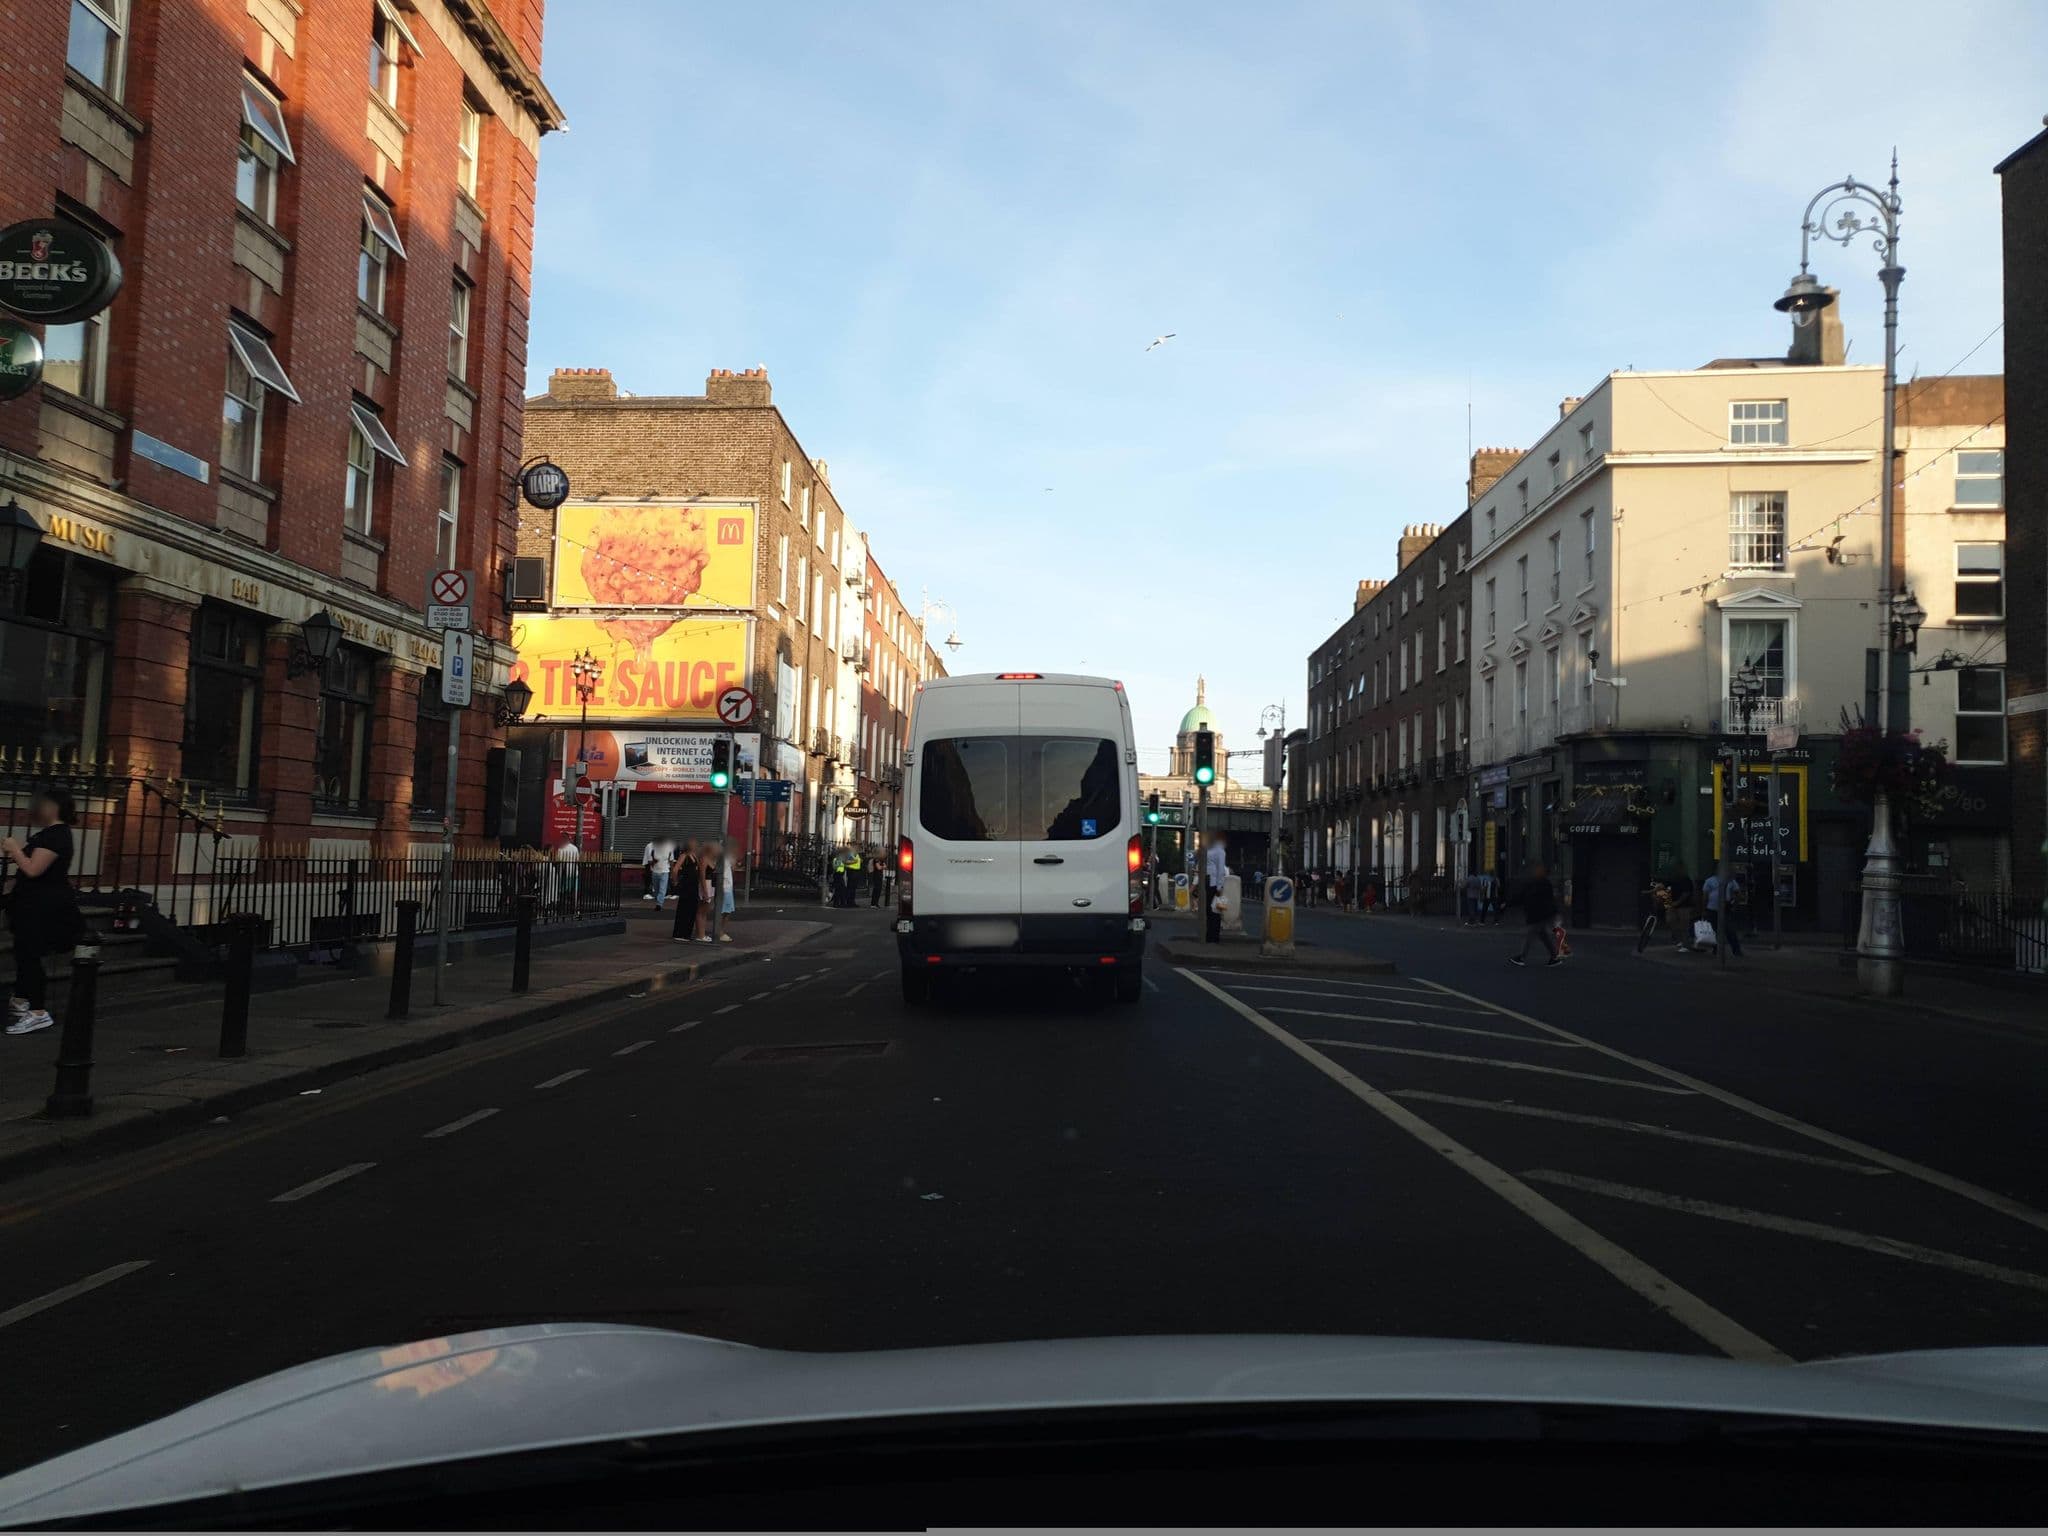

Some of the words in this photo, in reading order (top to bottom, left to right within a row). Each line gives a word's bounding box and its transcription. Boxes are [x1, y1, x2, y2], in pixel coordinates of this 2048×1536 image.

[529, 473, 559, 495] HARP
[49, 514, 115, 557] MUSIC
[232, 578, 260, 604] BAR
[540, 659, 606, 706] THE
[616, 660, 736, 709] SAUCE
[646, 736, 697, 745] UNLOCKING
[699, 737, 714, 746] MA
[657, 747, 698, 756] INTERNET
[701, 748, 713, 756] CA
[661, 757, 668, 765] &
[670, 757, 692, 766] CALL
[694, 758, 712, 766] SHO
[1569, 825, 1601, 833] COFFEE
